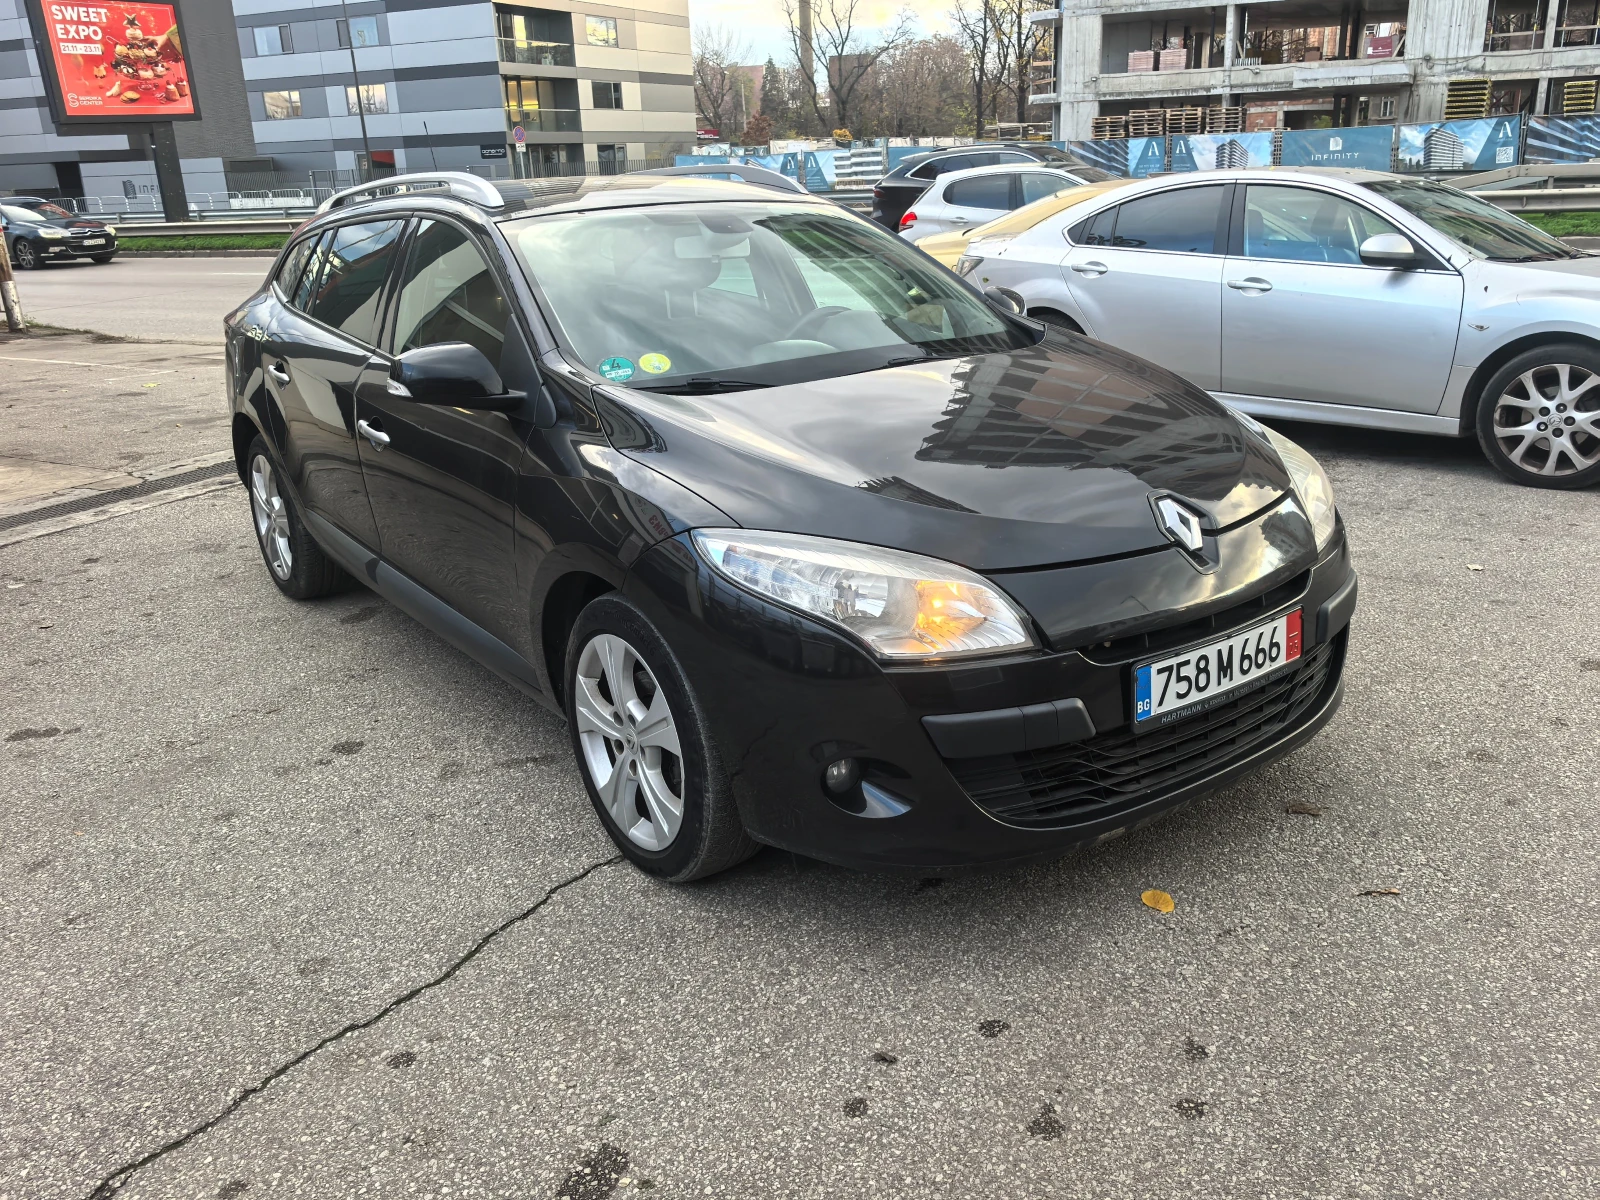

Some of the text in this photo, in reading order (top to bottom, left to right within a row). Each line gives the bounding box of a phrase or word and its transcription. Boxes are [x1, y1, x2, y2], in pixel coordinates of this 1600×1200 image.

[51, 5, 107, 23] SWEET
[55, 24, 102, 41] EXPO
[62, 44, 78, 52] 21.11
[84, 45, 100, 53] 23.11
[1311, 152, 1360, 161] INFINITY
[611, 358, 621, 369] 4
[1156, 625, 1281, 708] 758 M 666
[1137, 699, 1150, 714] BG
[1161, 702, 1202, 724] HARTMANN
